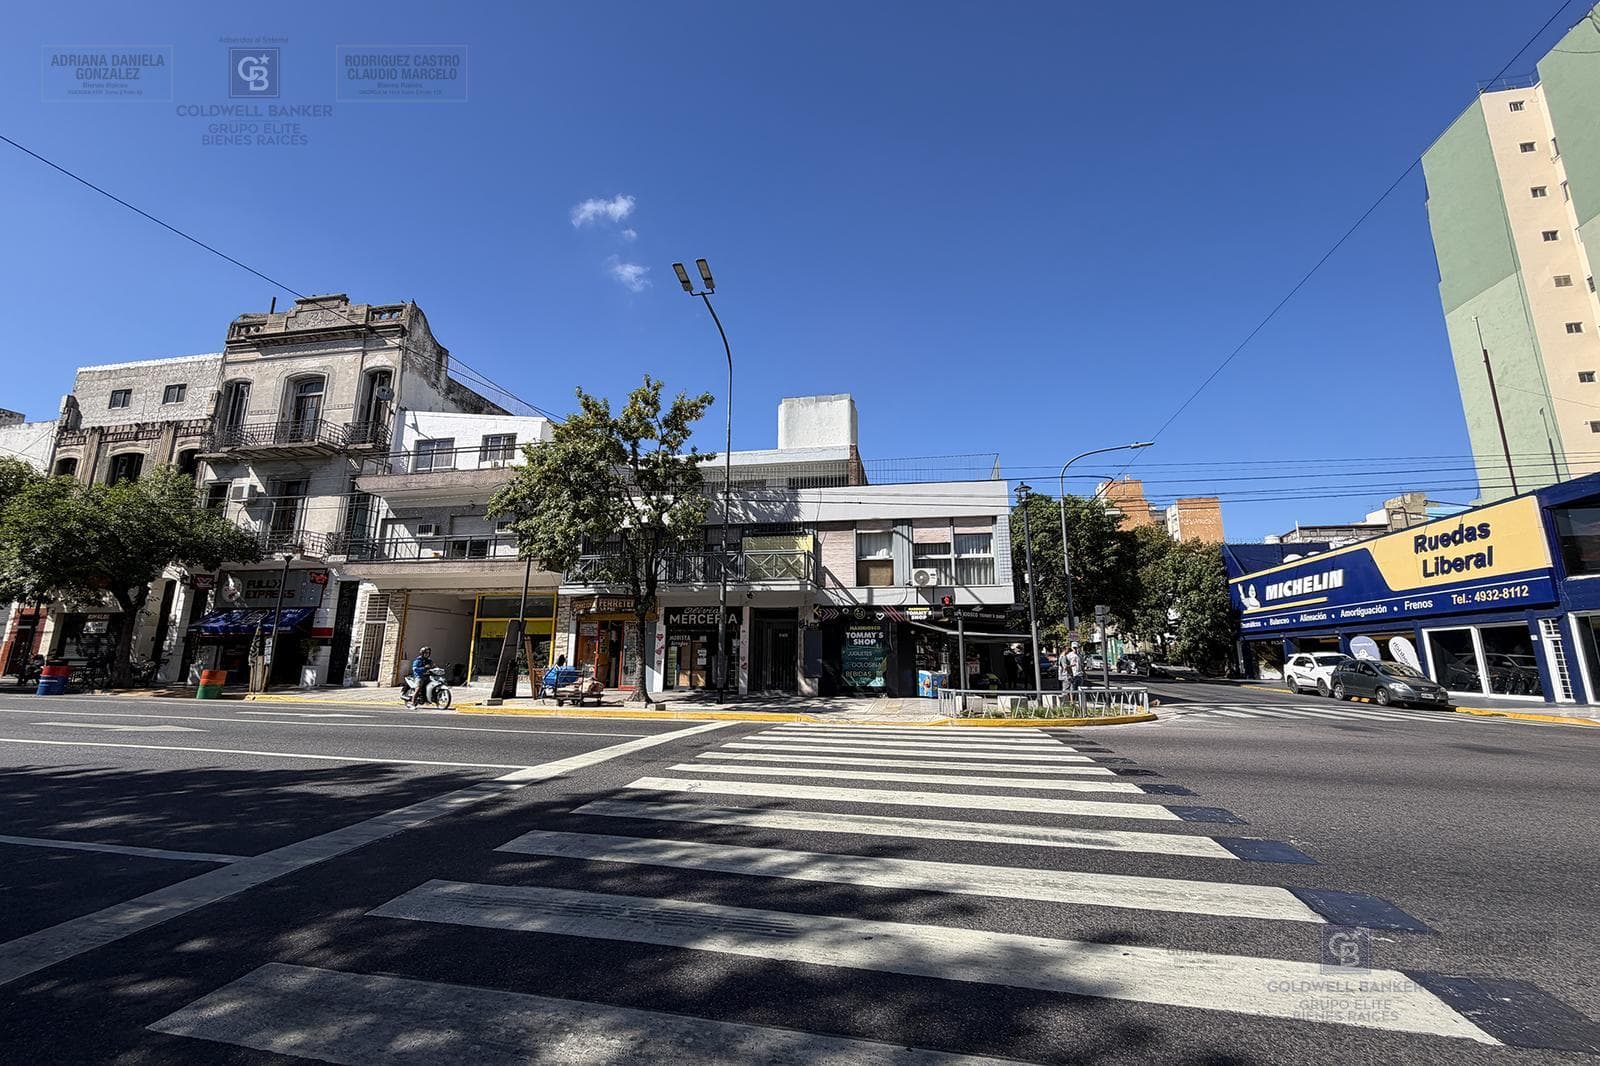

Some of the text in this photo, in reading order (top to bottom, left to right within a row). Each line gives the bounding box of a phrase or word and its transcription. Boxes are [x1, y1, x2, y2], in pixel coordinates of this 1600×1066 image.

[1414, 522, 1491, 555] Ruedas
[1422, 545, 1494, 578] Liberal
[246, 580, 272, 588] FULL
[1265, 569, 1344, 601] MICHELIN
[1451, 584, 1529, 605] Tel.: 4932-8112
[1340, 604, 1387, 618] Amortiguación
[1404, 599, 1433, 611] Frenos
